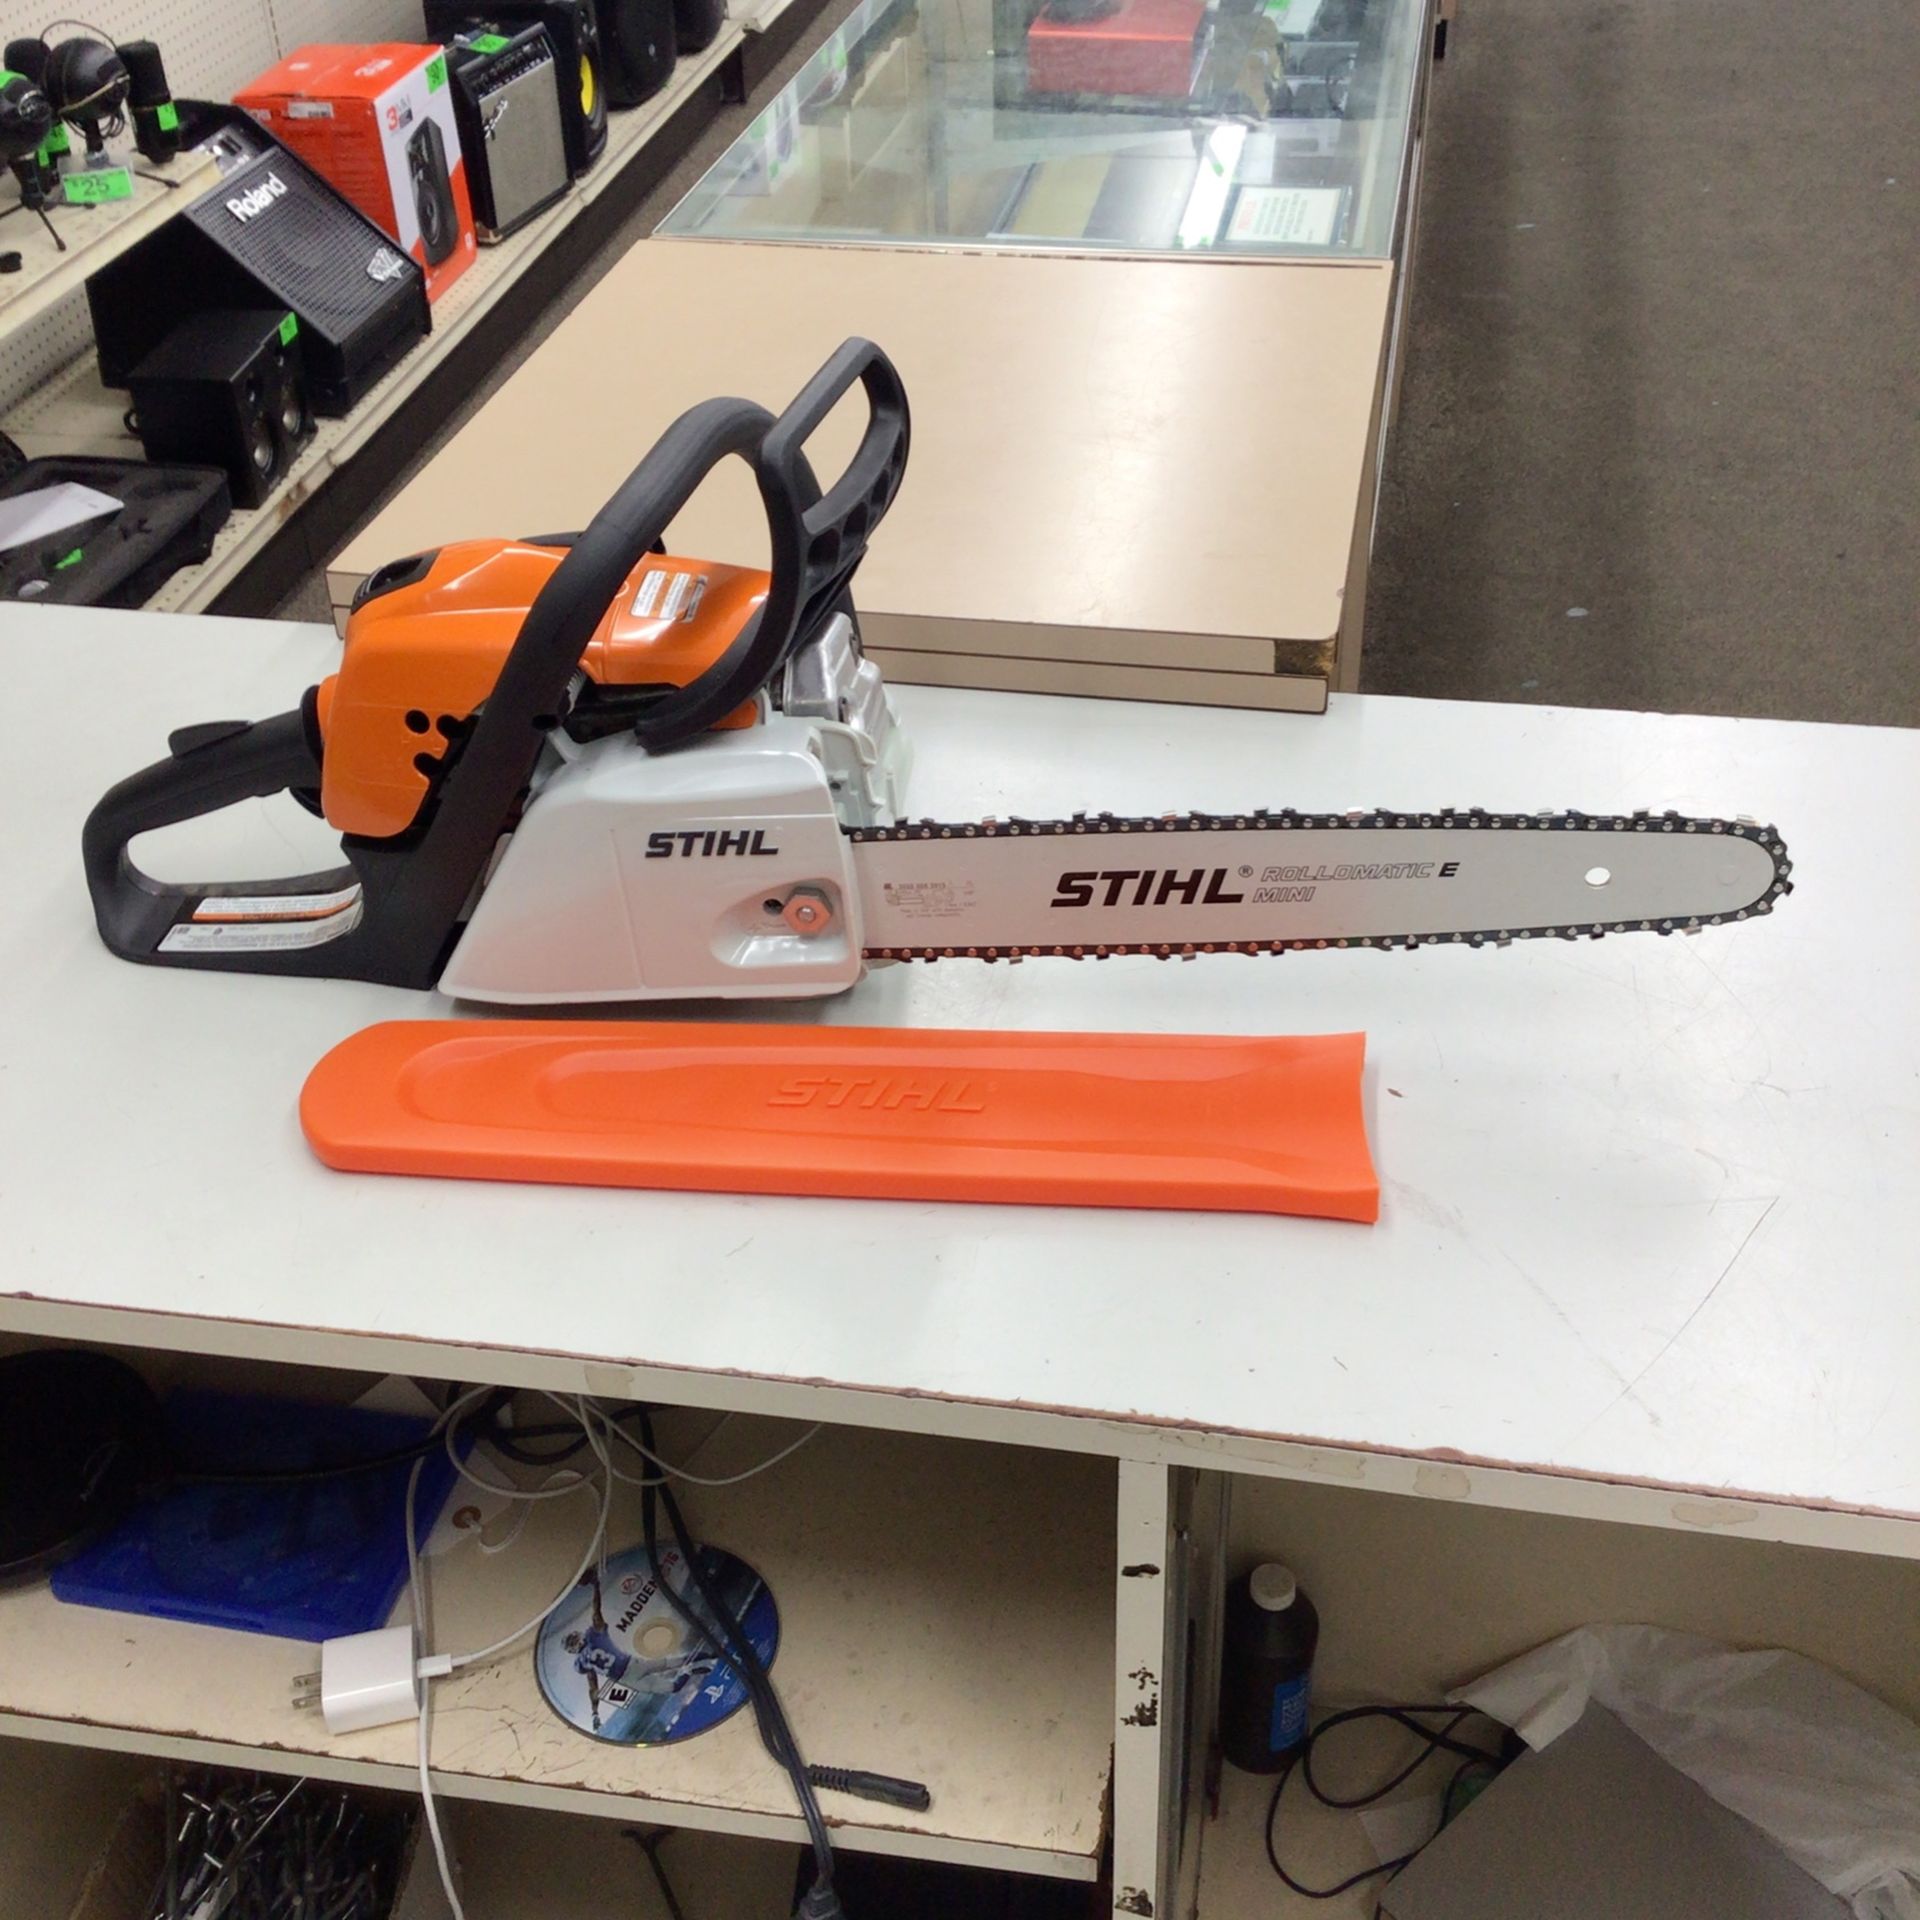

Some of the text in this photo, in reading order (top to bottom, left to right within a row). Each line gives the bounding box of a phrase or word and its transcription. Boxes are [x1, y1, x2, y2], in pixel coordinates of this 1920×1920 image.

[226, 171, 288, 223] Roland
[645, 829, 779, 858] STIHL
[1051, 861, 1460, 907] STIHL ROLLOMATIC E
[1252, 886, 1316, 903] MINI
[767, 1077, 985, 1114] STIHL
[609, 1688, 628, 1702] E
